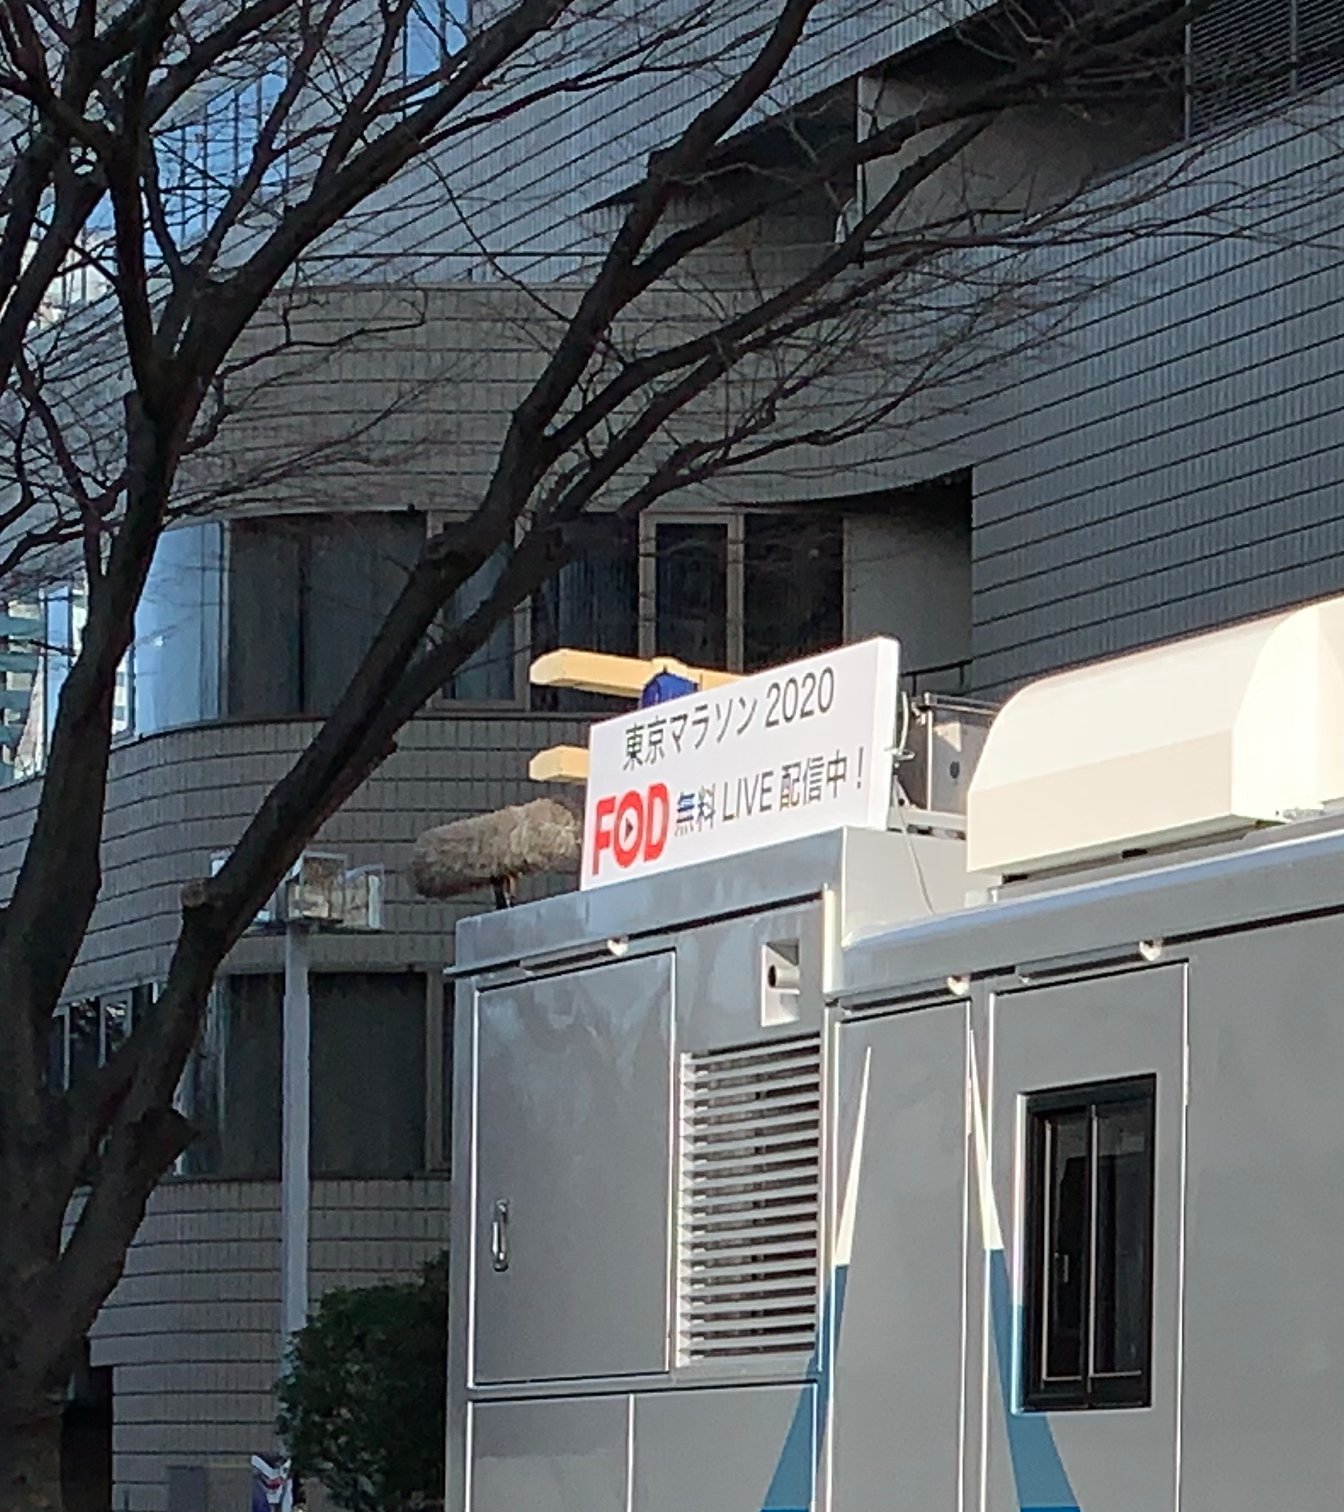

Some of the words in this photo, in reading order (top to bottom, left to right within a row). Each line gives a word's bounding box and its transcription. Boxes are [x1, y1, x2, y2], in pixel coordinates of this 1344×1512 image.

[623, 697, 758, 772] 東京マラソン
[764, 666, 834, 728] 2020
[591, 781, 670, 876] FOD
[674, 783, 716, 838] 無料
[722, 770, 773, 823] LIVE
